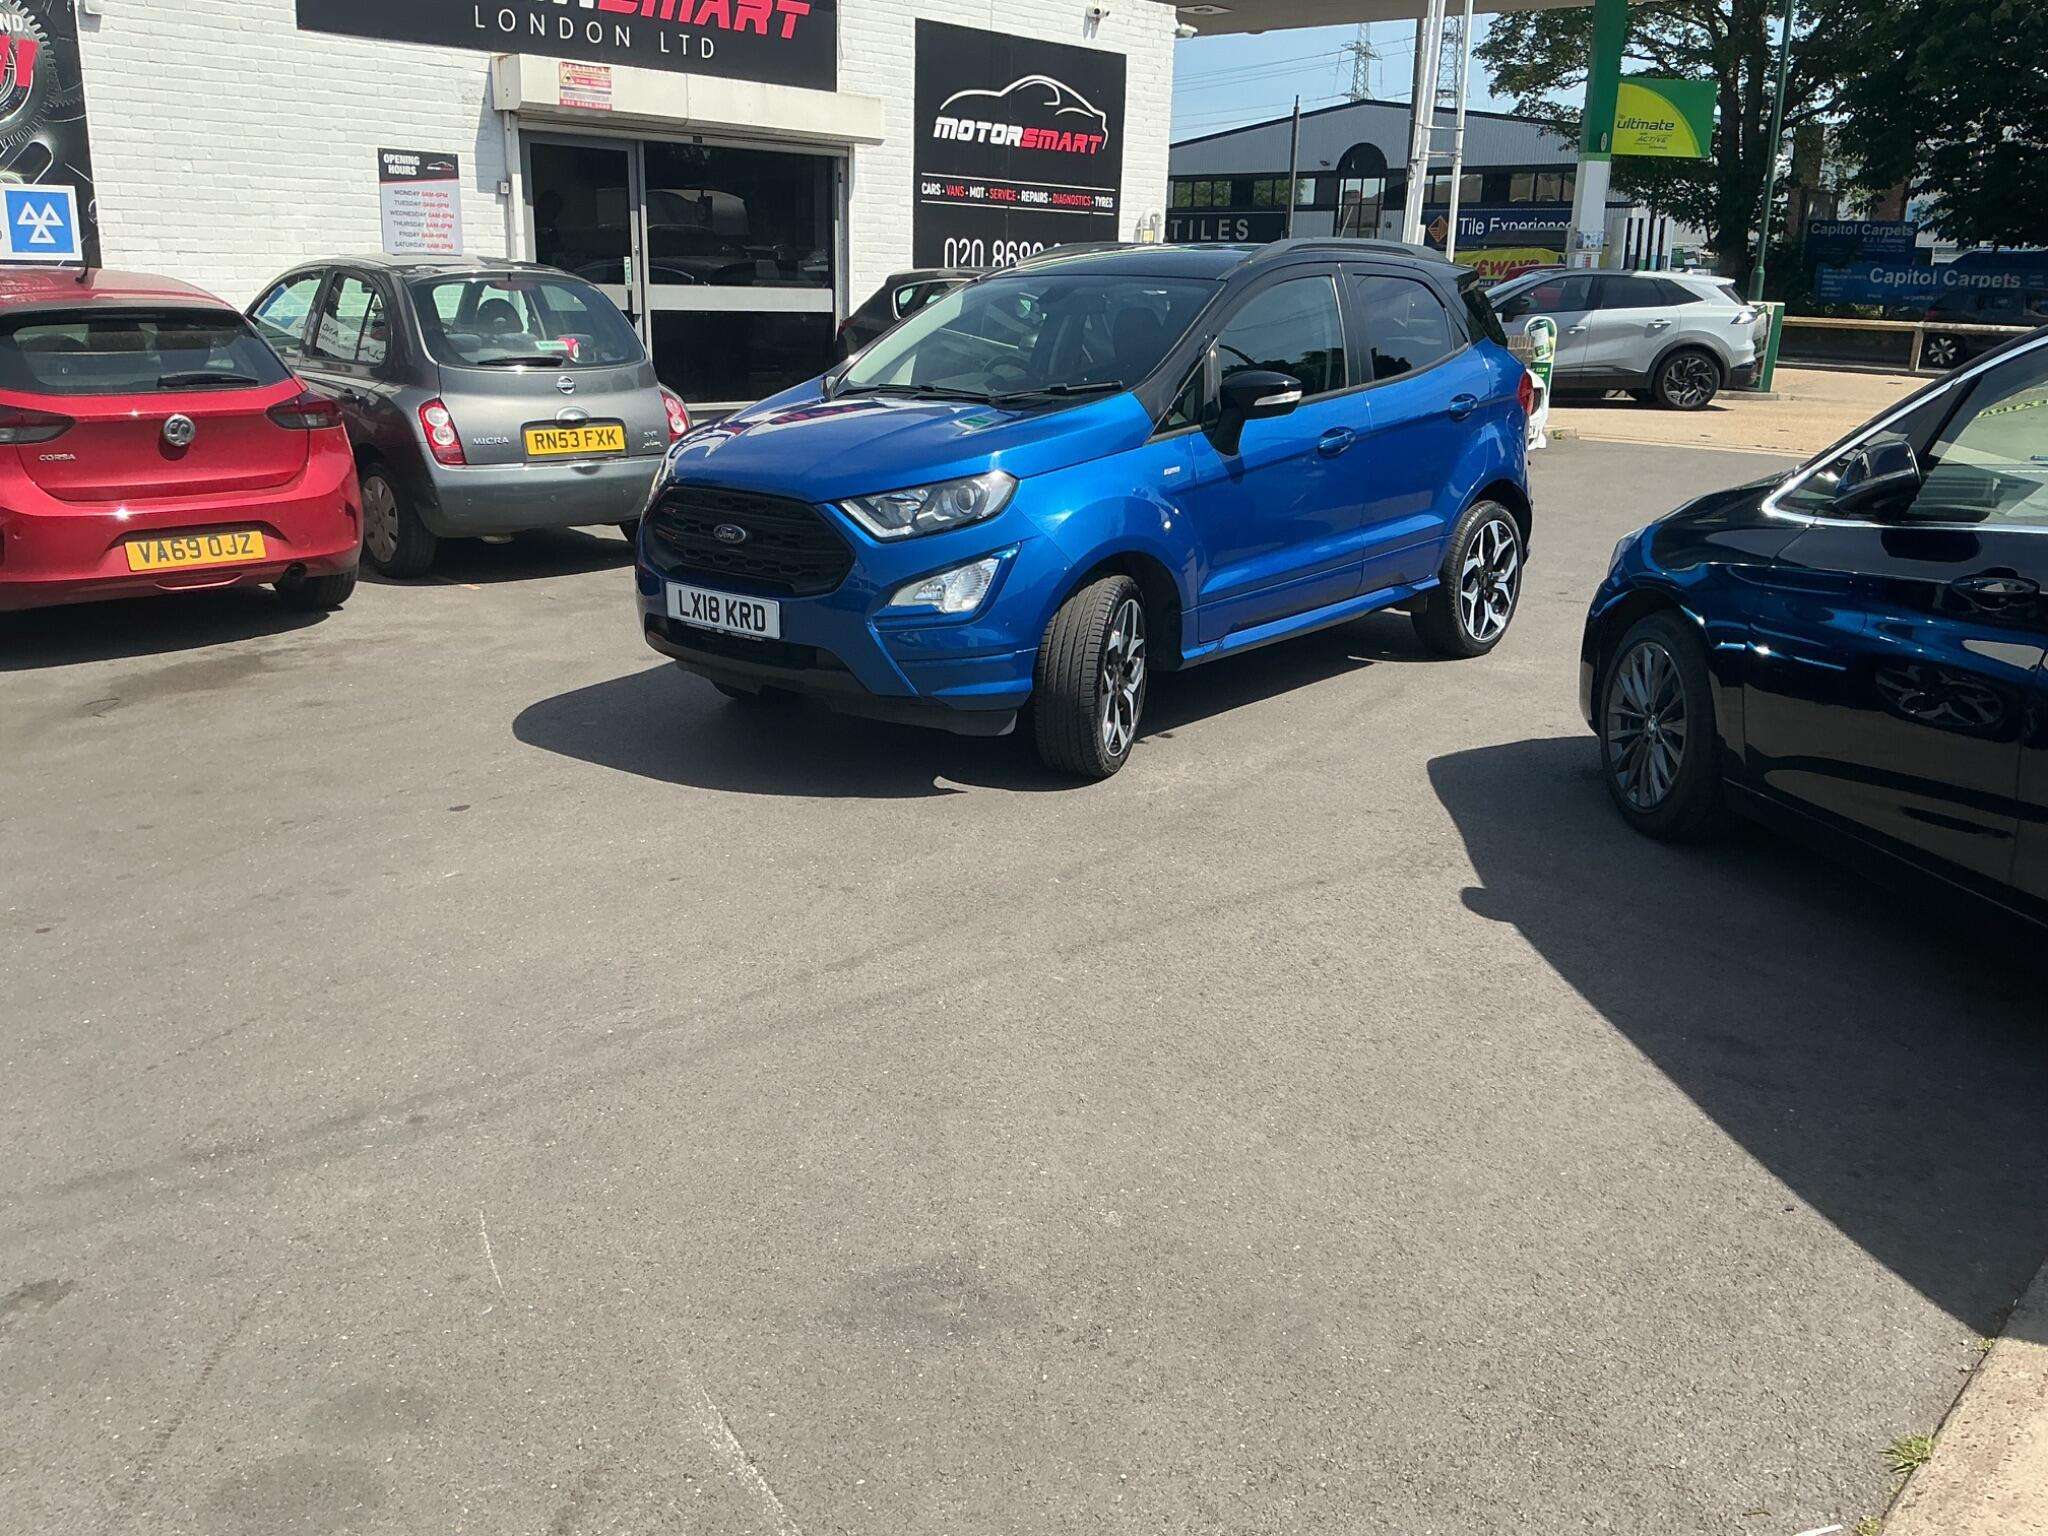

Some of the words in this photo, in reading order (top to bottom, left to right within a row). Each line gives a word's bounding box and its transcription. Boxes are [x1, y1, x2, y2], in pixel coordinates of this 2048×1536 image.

[475, 6, 630, 47] LONDON
[660, 31, 714, 59] LTD
[1617, 118, 1675, 130] ultimate
[383, 153, 420, 165] OPENING
[388, 164, 417, 175] HOURS
[921, 182, 941, 196] CARS
[946, 184, 965, 197] VANS
[969, 186, 986, 199] MOT
[989, 187, 1017, 201] SERVICE
[1021, 190, 1049, 203] REPAIRS
[1052, 192, 1092, 206] DIAGNOSTICS
[1095, 196, 1114, 208] TYRES
[1170, 218, 1249, 241] TILES
[1459, 217, 1485, 236] Tile
[1810, 222, 1858, 237] Capitol
[1861, 223, 1914, 238] Carpets
[944, 237, 985, 268] 020
[1869, 267, 1937, 288] Capitol
[1943, 269, 2021, 289] Carpets
[472, 436, 509, 445] MICRA
[534, 431, 580, 450] RN53
[584, 428, 618, 446] FXK
[39, 453, 76, 461] CORSA
[137, 536, 201, 564] VA69
[209, 533, 254, 556] OJZ
[678, 589, 720, 623] LX18
[725, 599, 766, 632] KRD
